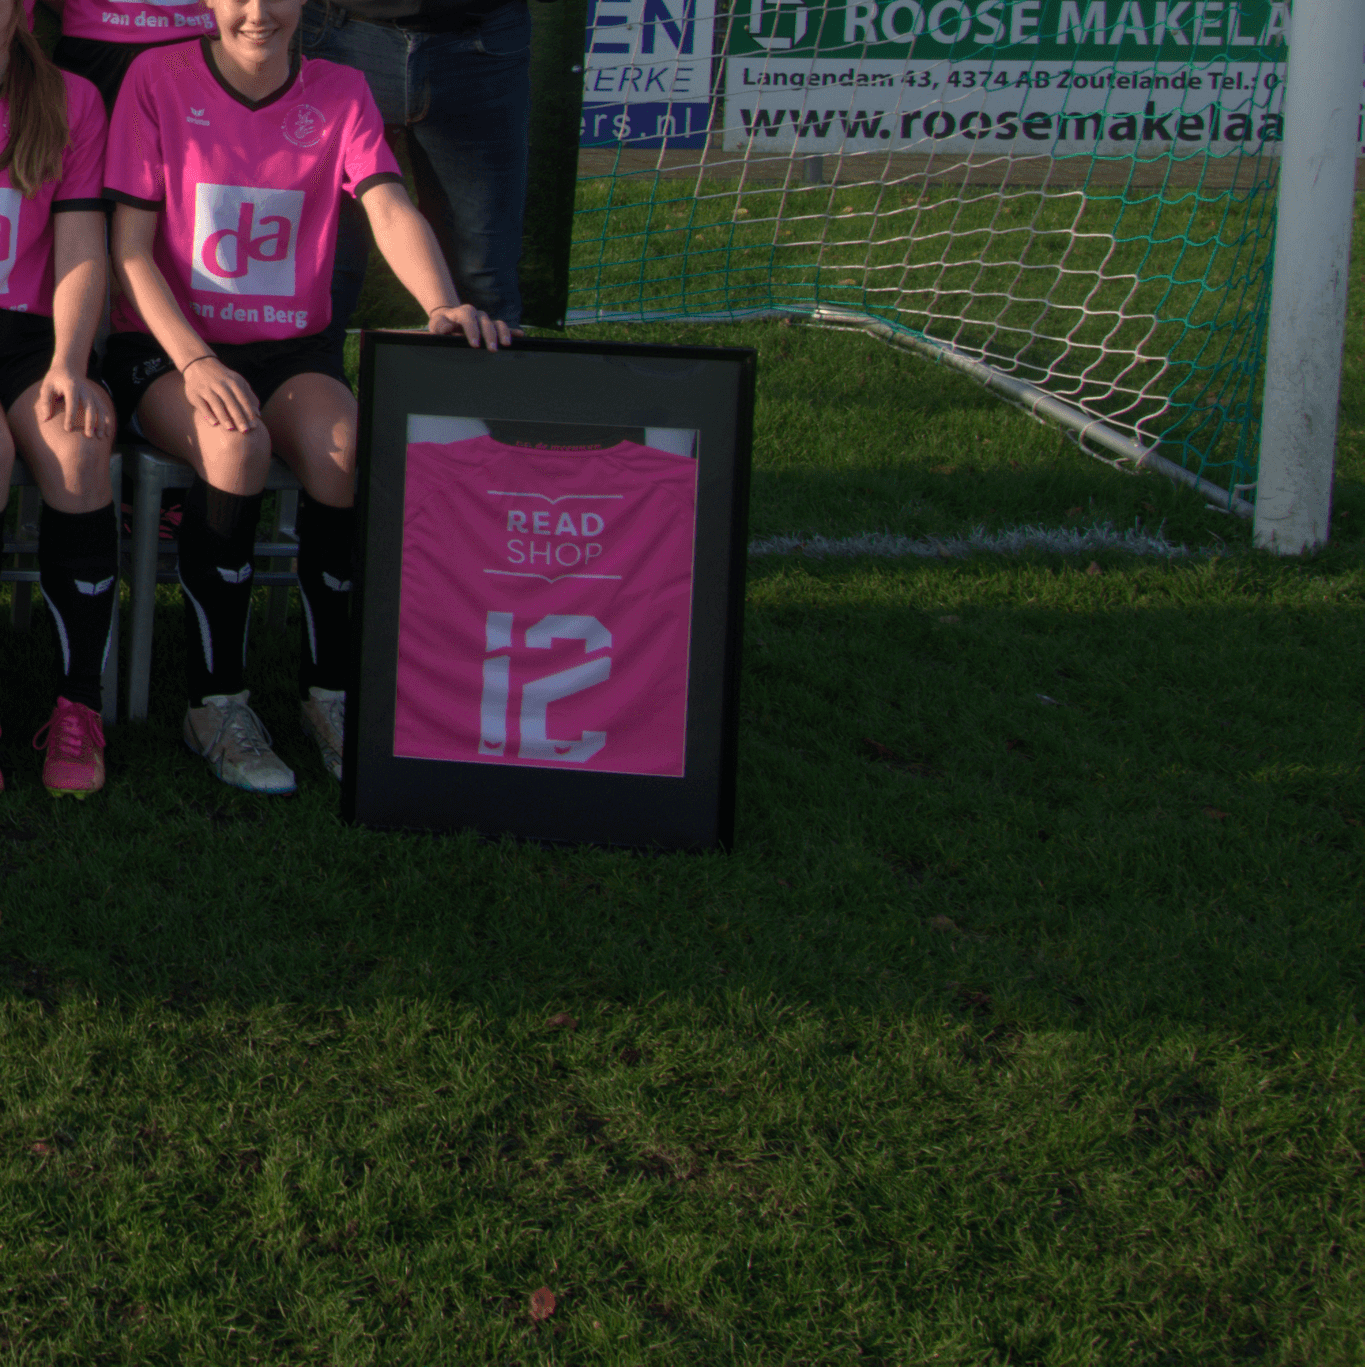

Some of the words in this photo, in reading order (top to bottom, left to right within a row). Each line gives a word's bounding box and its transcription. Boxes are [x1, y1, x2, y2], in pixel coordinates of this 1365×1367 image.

[102, 12, 130, 25] van
[134, 11, 168, 27] den
[173, 12, 214, 30] Berg
[742, 67, 894, 91] Langendam
[901, 70, 940, 90] 43,
[947, 70, 1009, 88] 4374
[1015, 70, 1050, 89] AB
[1056, 71, 1202, 90] Zoutelande
[202, 203, 291, 279] da
[189, 300, 214, 318] an
[220, 302, 258, 322] den
[263, 305, 308, 329] Berg
[507, 508, 605, 537] READ
[507, 538, 604, 566] SHOP
[478, 610, 613, 763] 12
